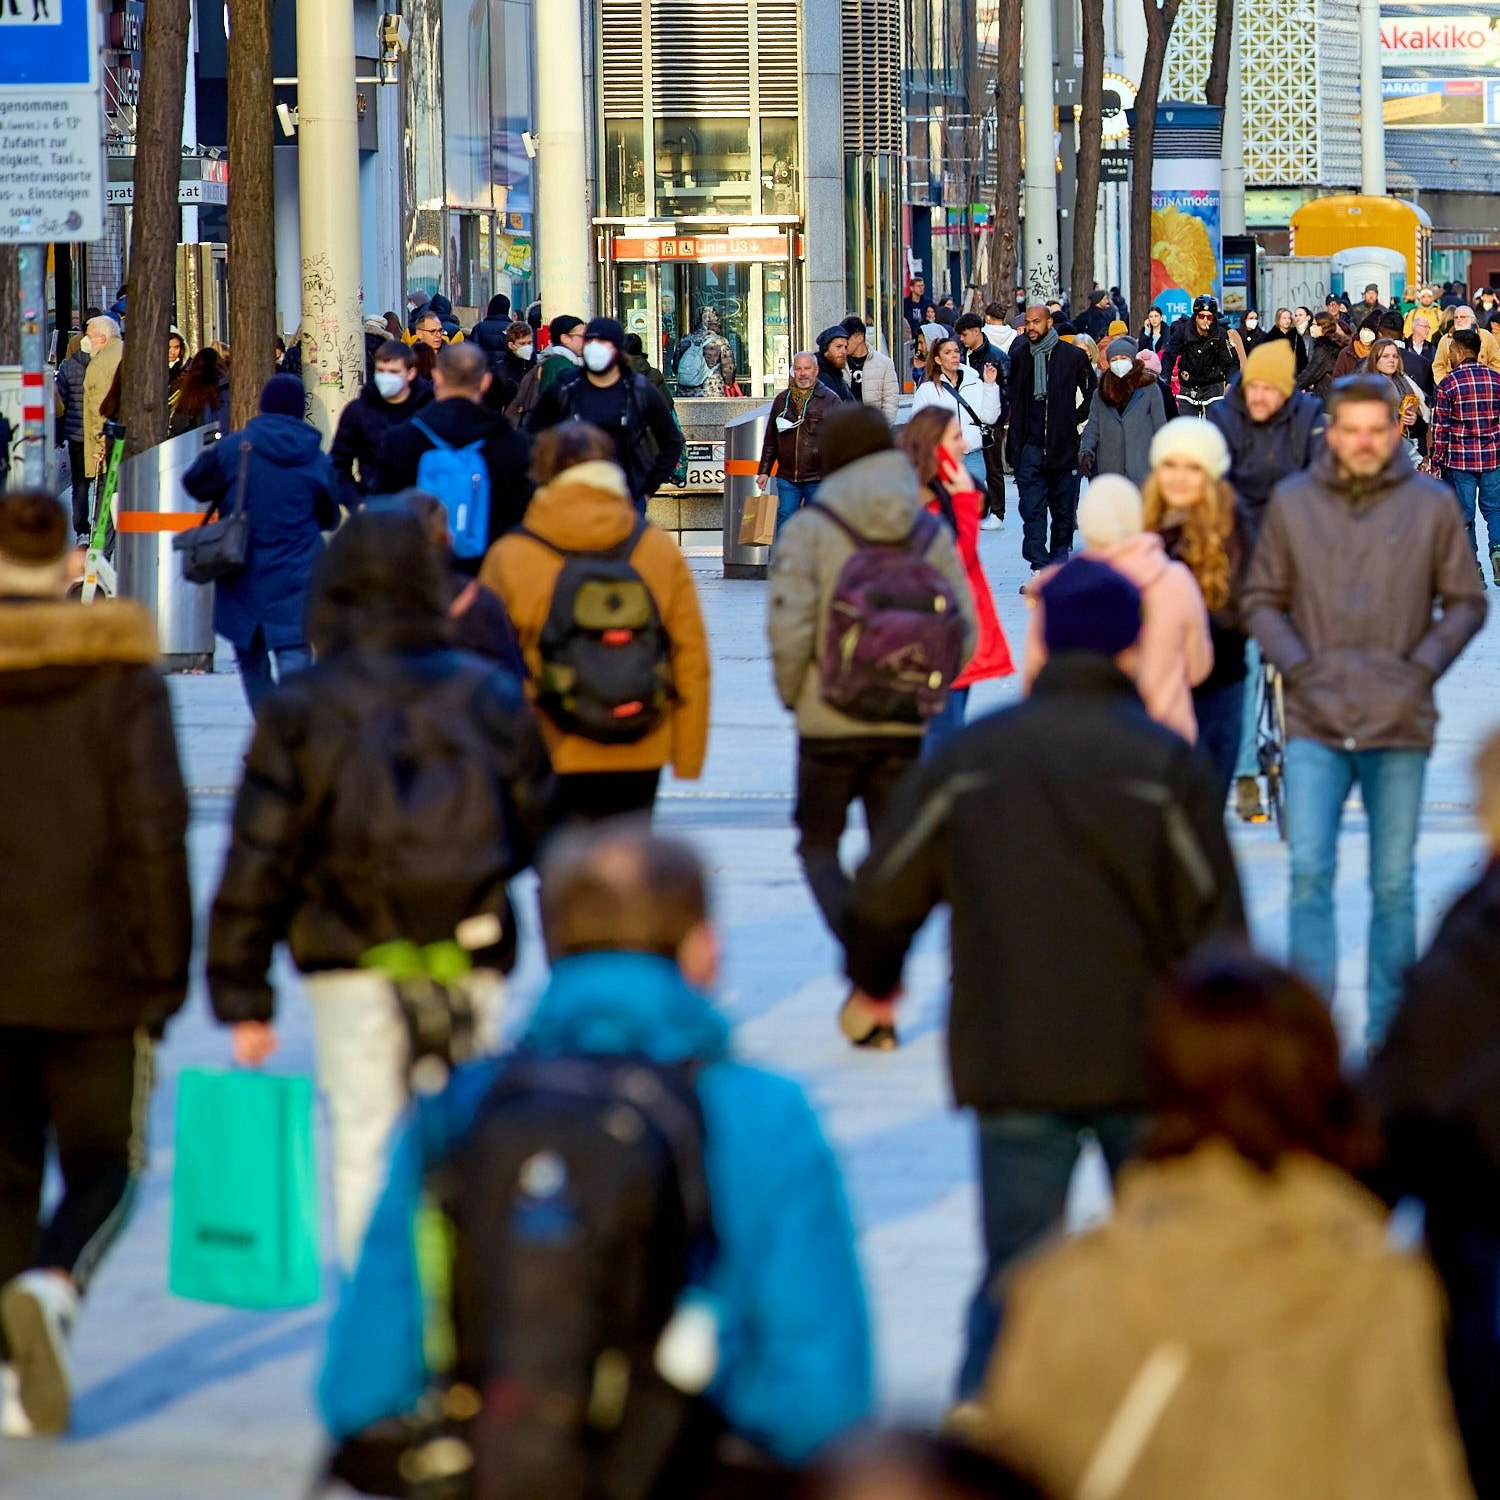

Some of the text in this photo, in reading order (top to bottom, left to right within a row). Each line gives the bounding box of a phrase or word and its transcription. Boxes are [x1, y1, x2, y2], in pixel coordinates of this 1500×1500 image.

[1379, 25, 1485, 49] Akakiko
[2, 137, 68, 149] Zufahrt zur
[51, 153, 73, 165] Taxi
[28, 187, 89, 201] Einsteigen
[10, 207, 42, 217] sowie
[696, 240, 748, 253] Linie U3
[1166, 302, 1188, 313] THE
